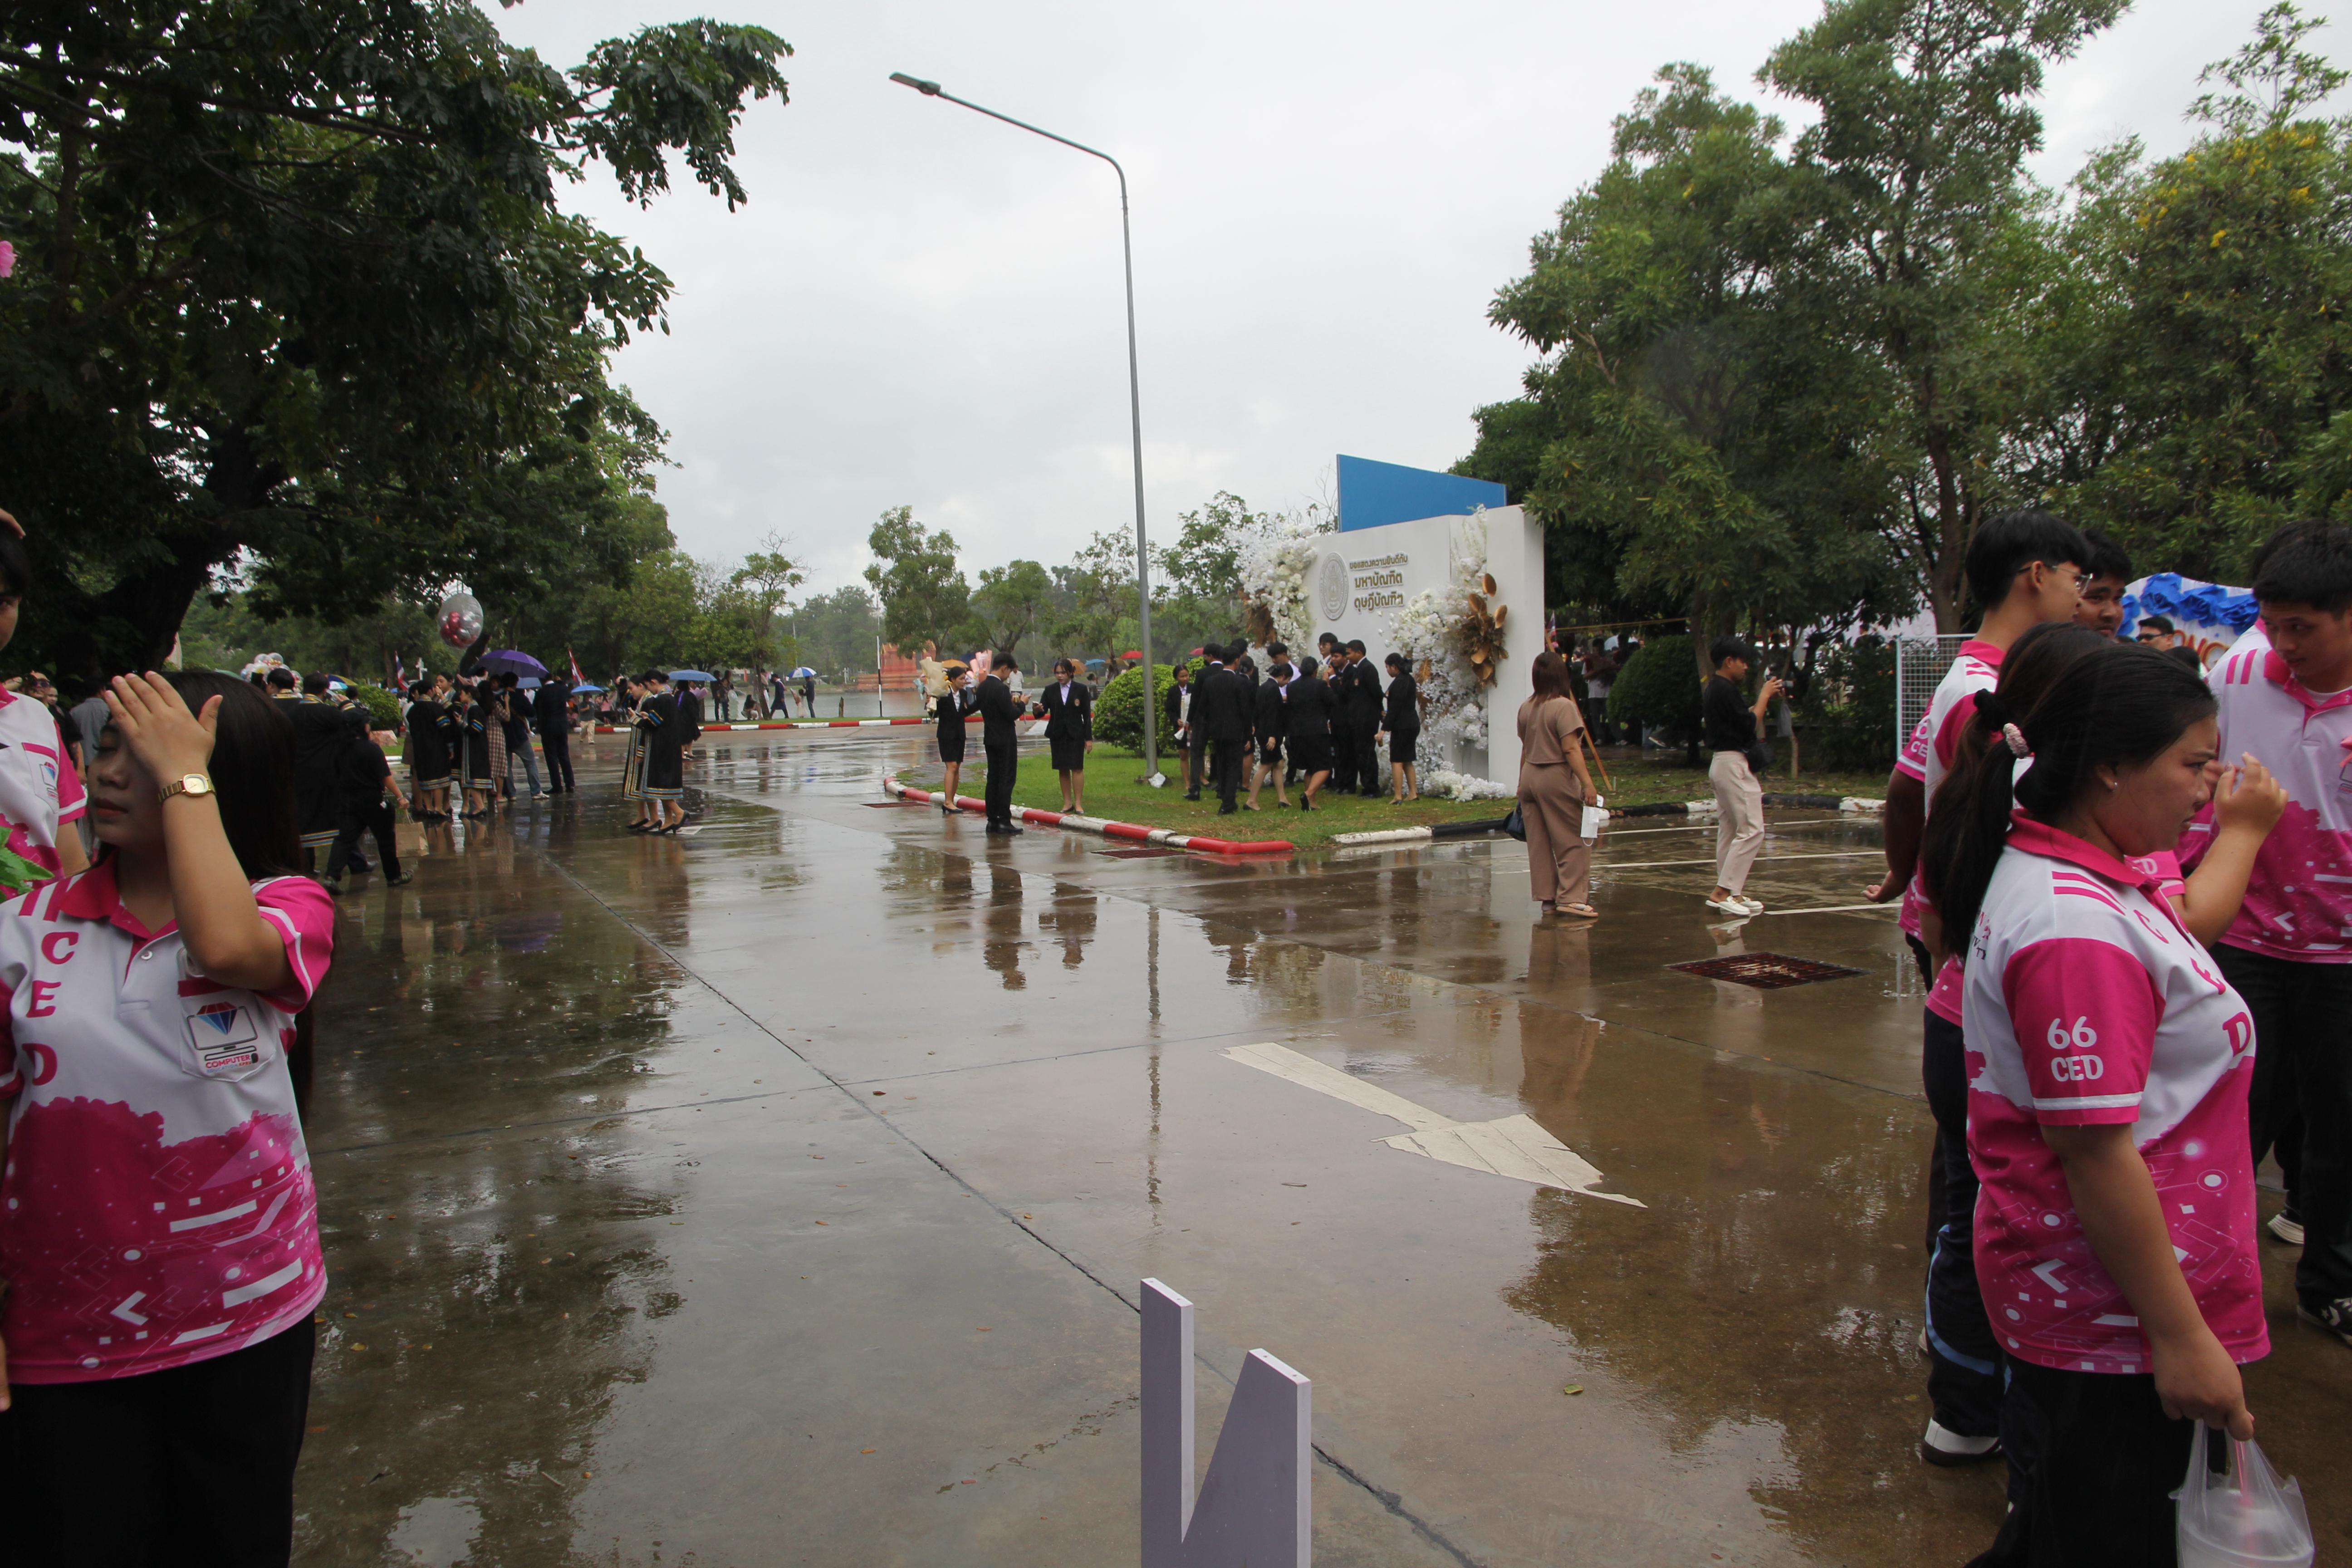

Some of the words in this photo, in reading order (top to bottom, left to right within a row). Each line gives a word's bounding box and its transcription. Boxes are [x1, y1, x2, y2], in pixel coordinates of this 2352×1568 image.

[1354, 570, 1402, 588] มหาบัณฑิต
[1353, 591, 1403, 612] ดุษฎีบัณฑิต
[1911, 740, 1928, 757] CE
[2047, 1016, 2097, 1049] 66
[206, 1054, 251, 1068] COMPUTER
[2051, 1054, 2104, 1082] CED
